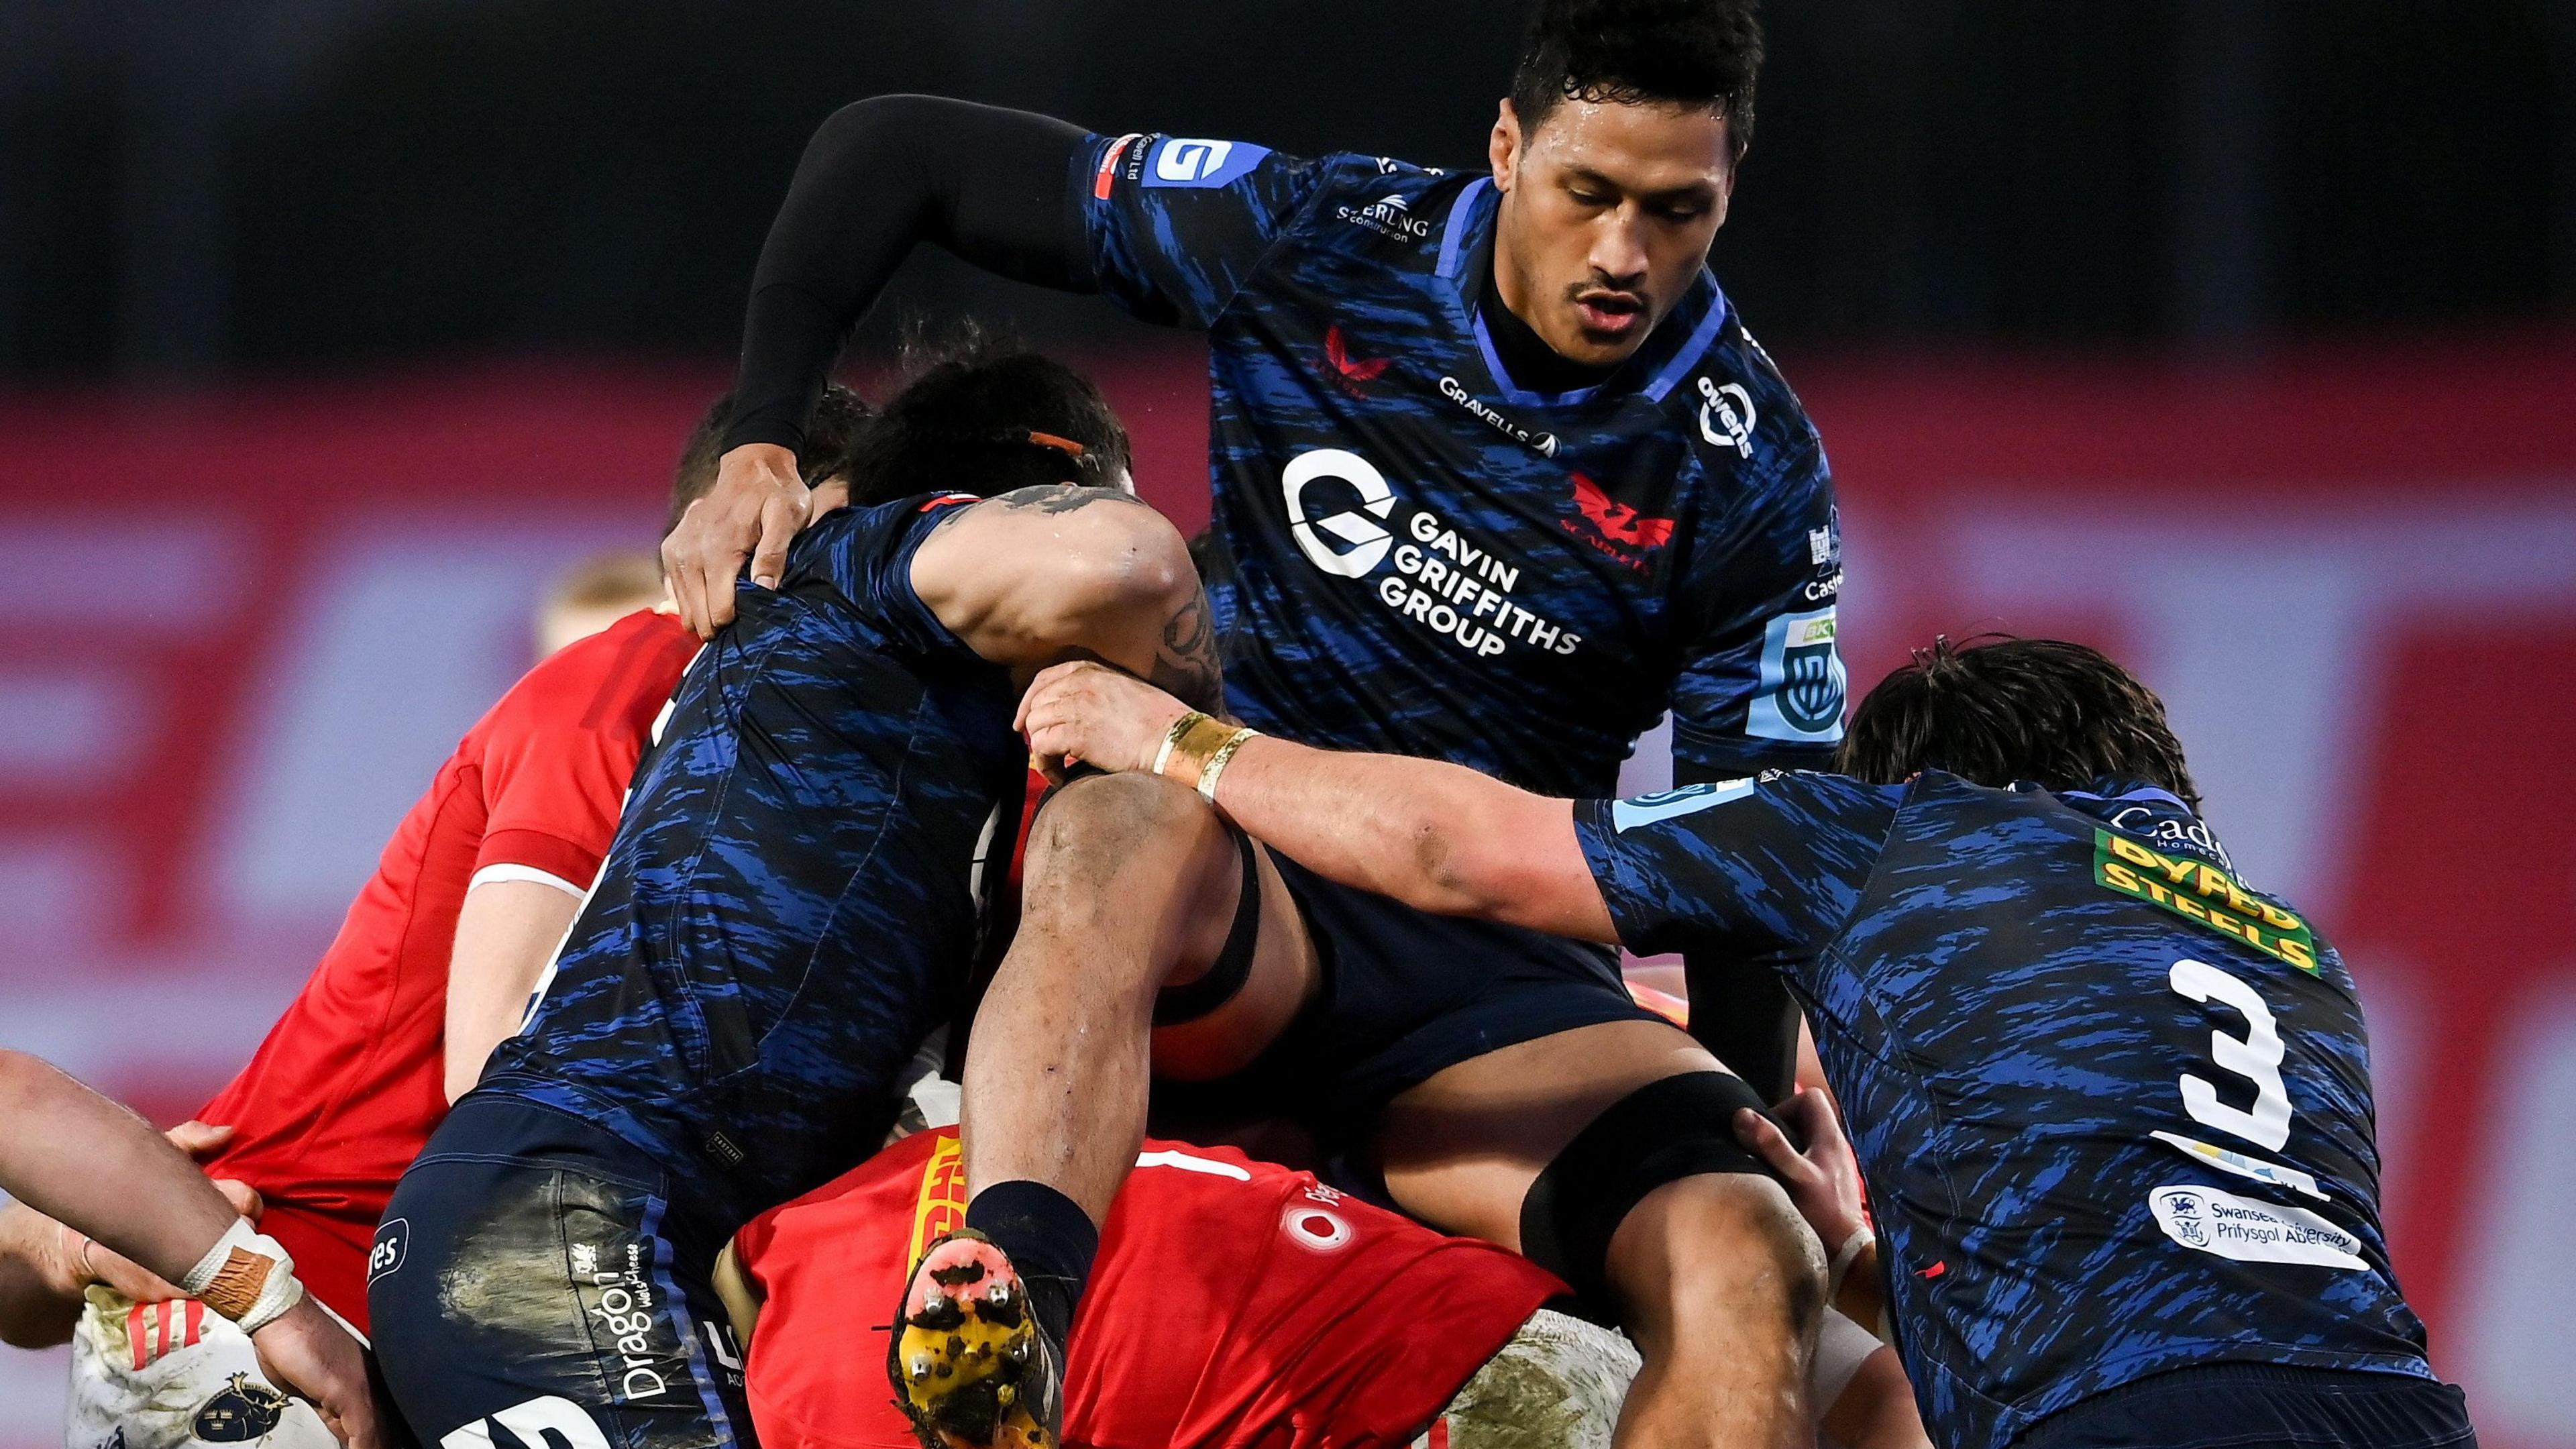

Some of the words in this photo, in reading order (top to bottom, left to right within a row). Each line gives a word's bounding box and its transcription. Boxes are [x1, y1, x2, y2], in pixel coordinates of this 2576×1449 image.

[1127, 162, 1140, 180] Ltd
[1336, 204, 1429, 237] SERLNG
[1349, 215, 1408, 243] construcion
[1439, 376, 1529, 443] GRAVELLS
[1698, 376, 1754, 460] owens
[1410, 512, 1519, 593] GAVIN
[1379, 577, 1506, 657] GROUP
[1394, 545, 1582, 655] GRIFFITHS
[2103, 863, 2314, 969] STEELS
[2109, 837, 2300, 930] DYFED
[2169, 959, 2293, 1152] 3
[2217, 1222, 2280, 1246] Prifysgol
[591, 1271, 666, 1399] Dragon
